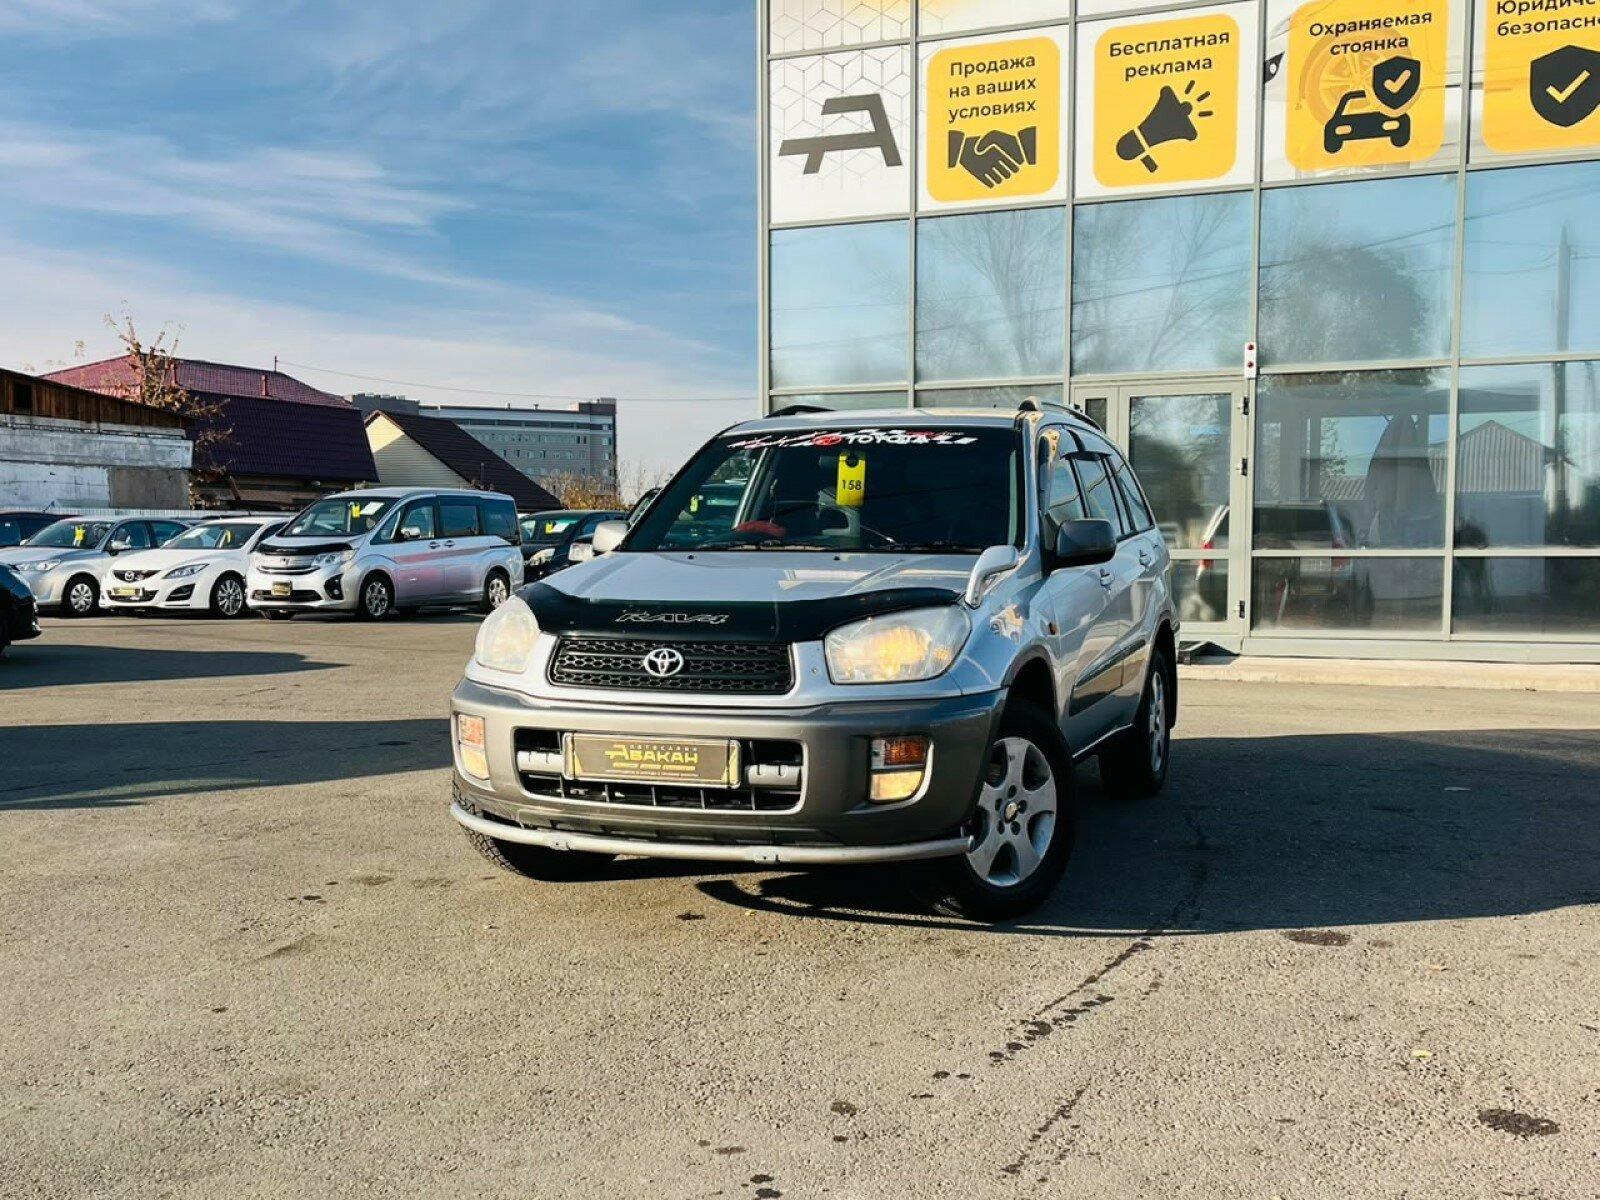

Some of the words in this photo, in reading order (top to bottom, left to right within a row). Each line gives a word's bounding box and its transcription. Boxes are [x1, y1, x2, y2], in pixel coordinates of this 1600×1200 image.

[1497, 0, 1600, 15] Юридич
[1309, 12, 1432, 37] Охраняемая
[1109, 32, 1230, 57] Бесплатная
[1330, 37, 1409, 55] стоянка
[950, 55, 1036, 78] Продажа
[1125, 57, 1212, 81] реклама
[949, 85, 970, 98] на
[976, 78, 1036, 95] ваших
[948, 99, 1036, 124] условиях
[841, 479, 863, 491] 158
